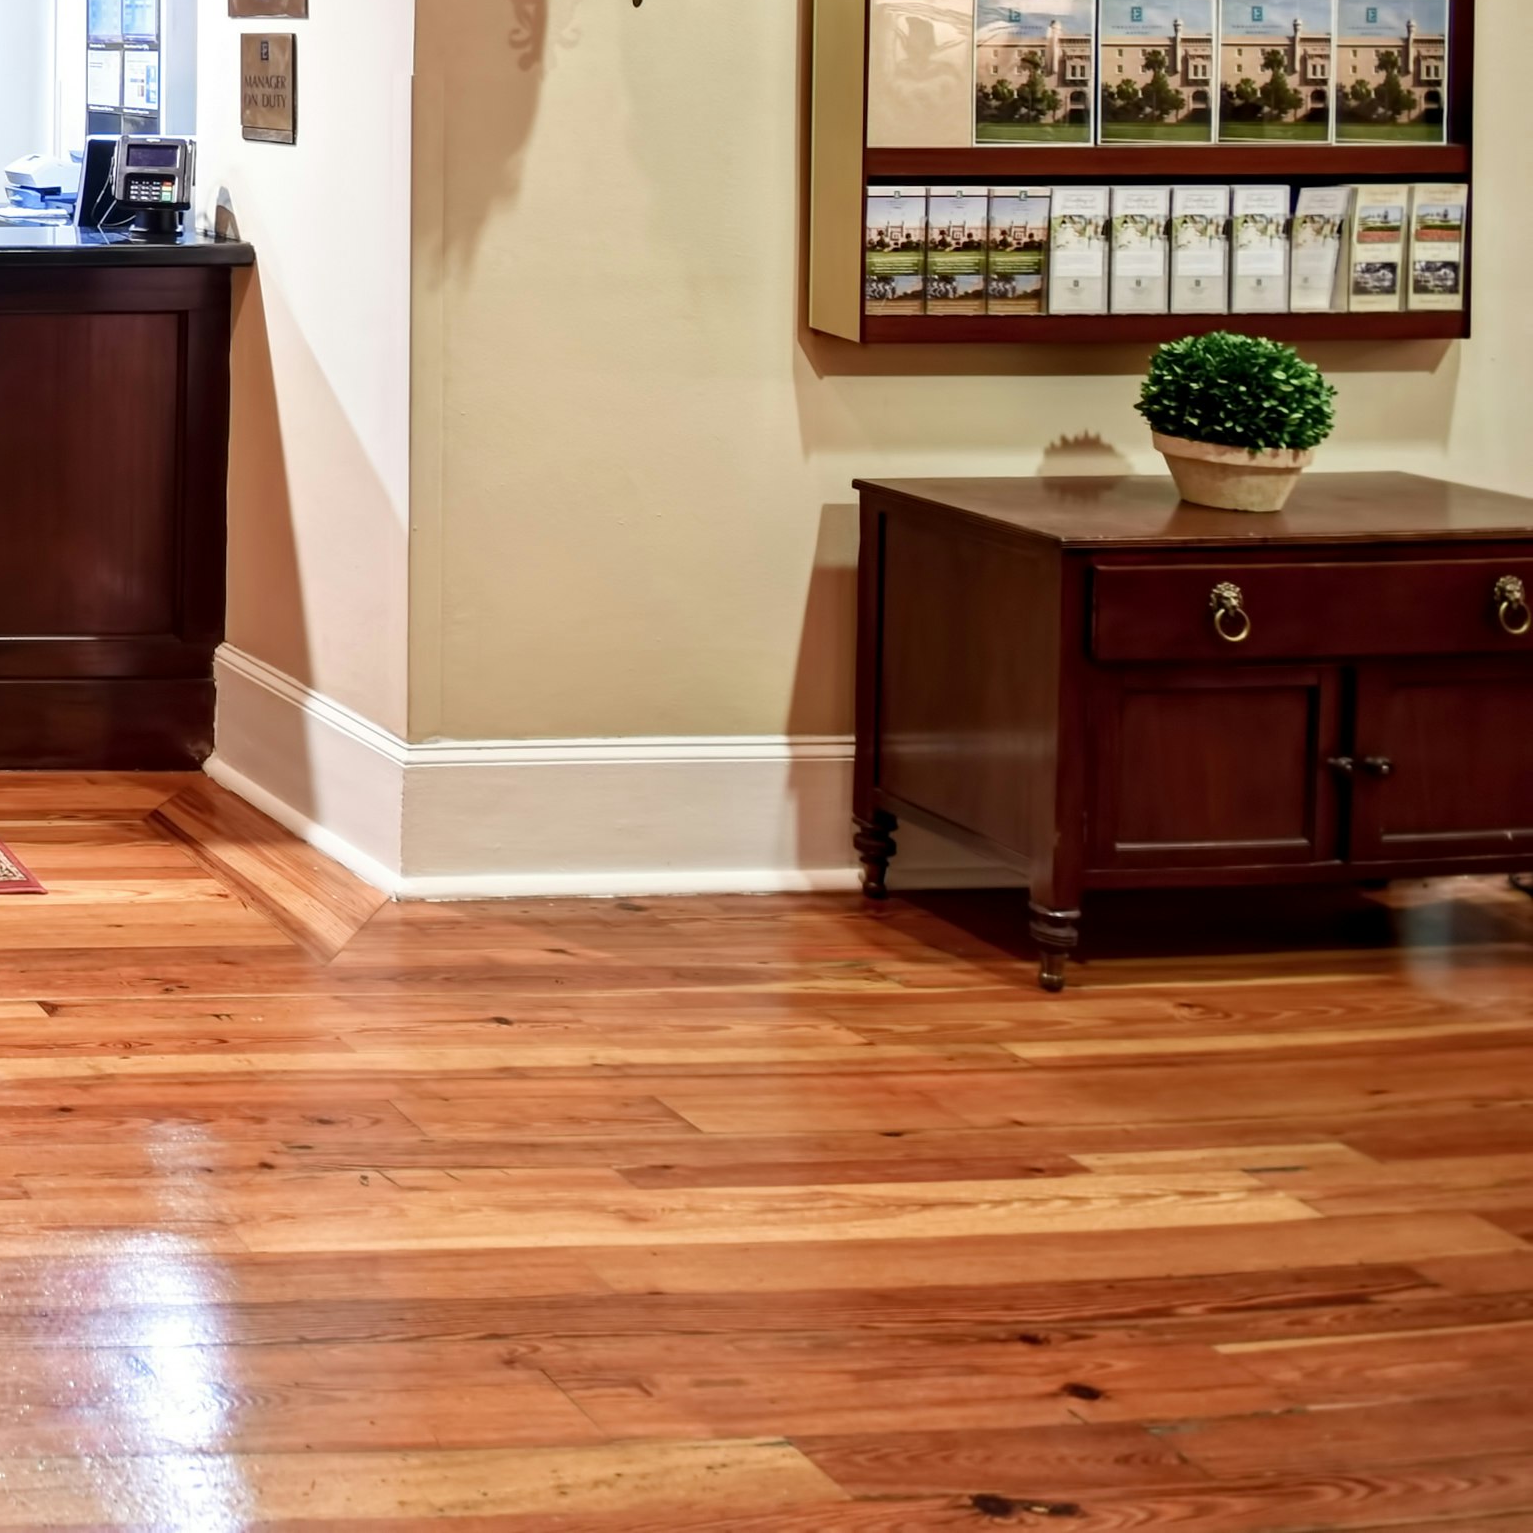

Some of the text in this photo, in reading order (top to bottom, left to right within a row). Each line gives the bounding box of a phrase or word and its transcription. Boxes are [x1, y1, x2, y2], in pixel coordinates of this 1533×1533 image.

[244, 74, 286, 90] MANAGER
[244, 92, 287, 109] ON DUTY
